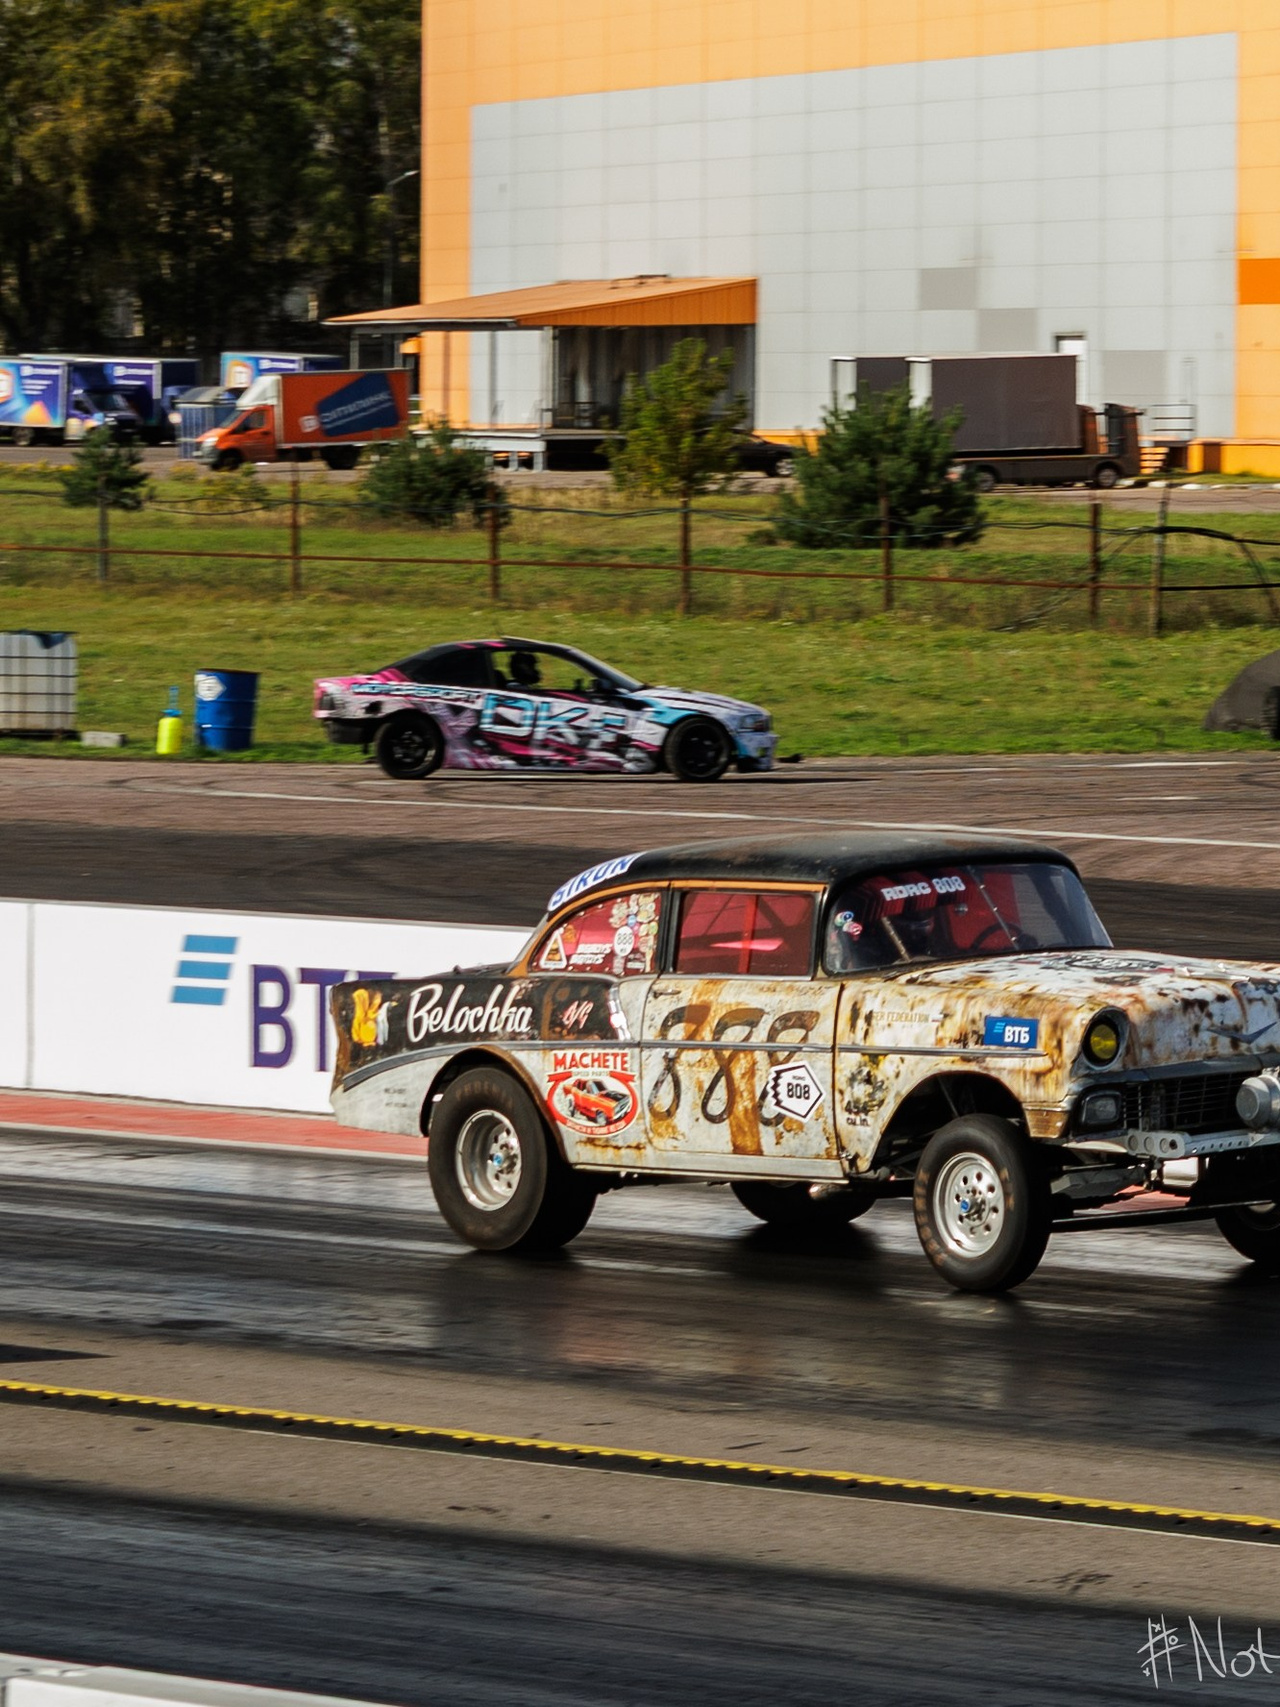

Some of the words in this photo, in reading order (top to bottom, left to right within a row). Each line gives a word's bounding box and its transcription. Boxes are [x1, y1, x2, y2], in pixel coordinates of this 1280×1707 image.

[932, 875, 966, 894] 808
[249, 963, 399, 1073] ВТ
[407, 983, 533, 1043] Belochka
[1003, 1025, 1030, 1044] ВТБ
[553, 1052, 629, 1072] MACHETE
[786, 1081, 810, 1100] 808
